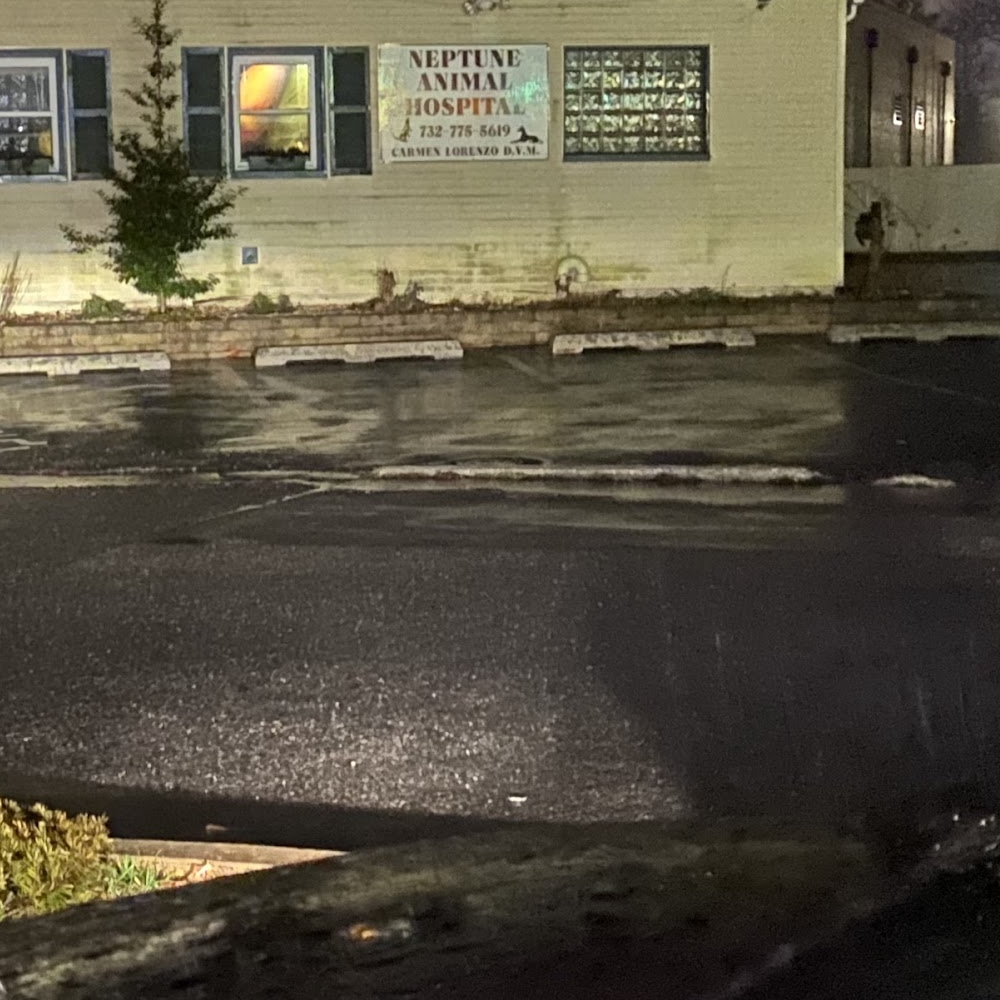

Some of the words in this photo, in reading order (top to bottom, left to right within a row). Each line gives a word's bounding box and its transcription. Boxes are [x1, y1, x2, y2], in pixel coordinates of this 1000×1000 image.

[409, 49, 521, 69] NEPTUNE
[416, 72, 513, 92] ANIMAL
[404, 97, 526, 117] HOSPITAL
[391, 147, 441, 158] CARMEN
[445, 146, 499, 157] LORENZO
